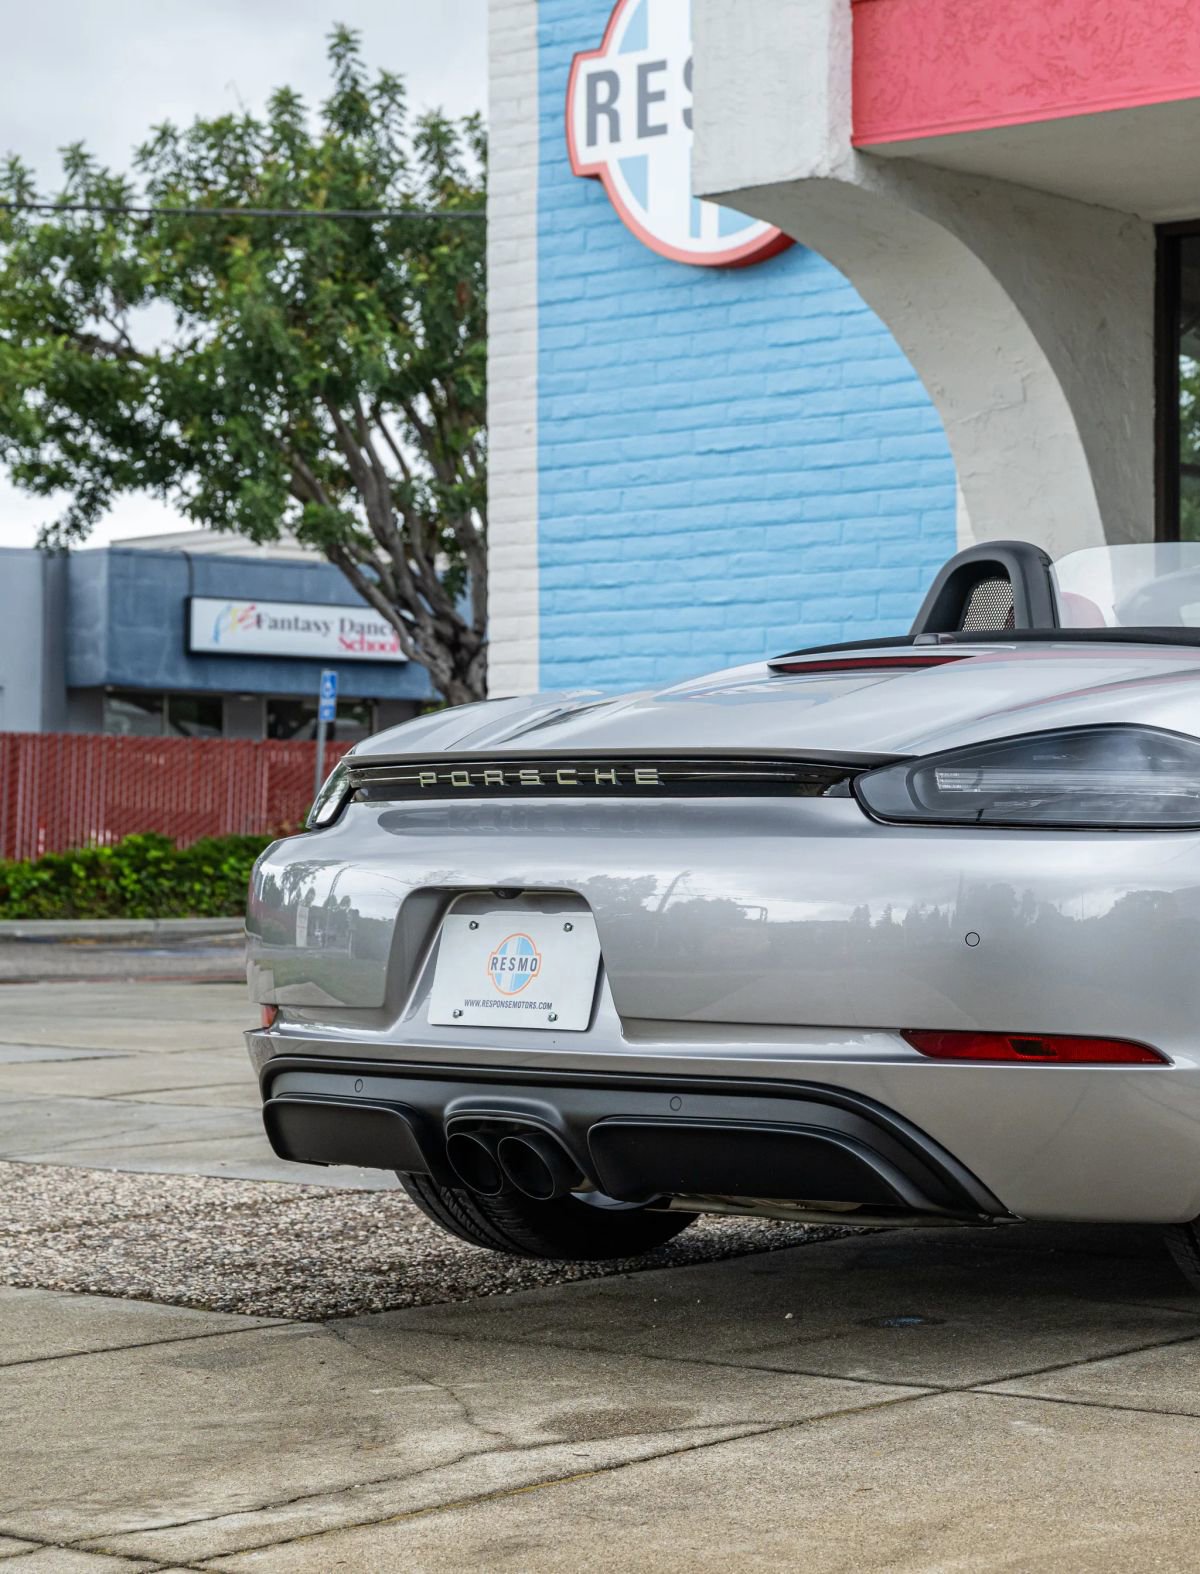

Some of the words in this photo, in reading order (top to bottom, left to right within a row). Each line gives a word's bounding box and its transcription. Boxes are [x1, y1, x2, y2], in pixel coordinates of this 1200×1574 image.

[255, 613, 331, 637] Fantasy
[419, 768, 660, 787] PORSCHE
[490, 956, 538, 972] RESMO
[464, 999, 552, 1010] WWW.RESPONSEMOTORS.COM
